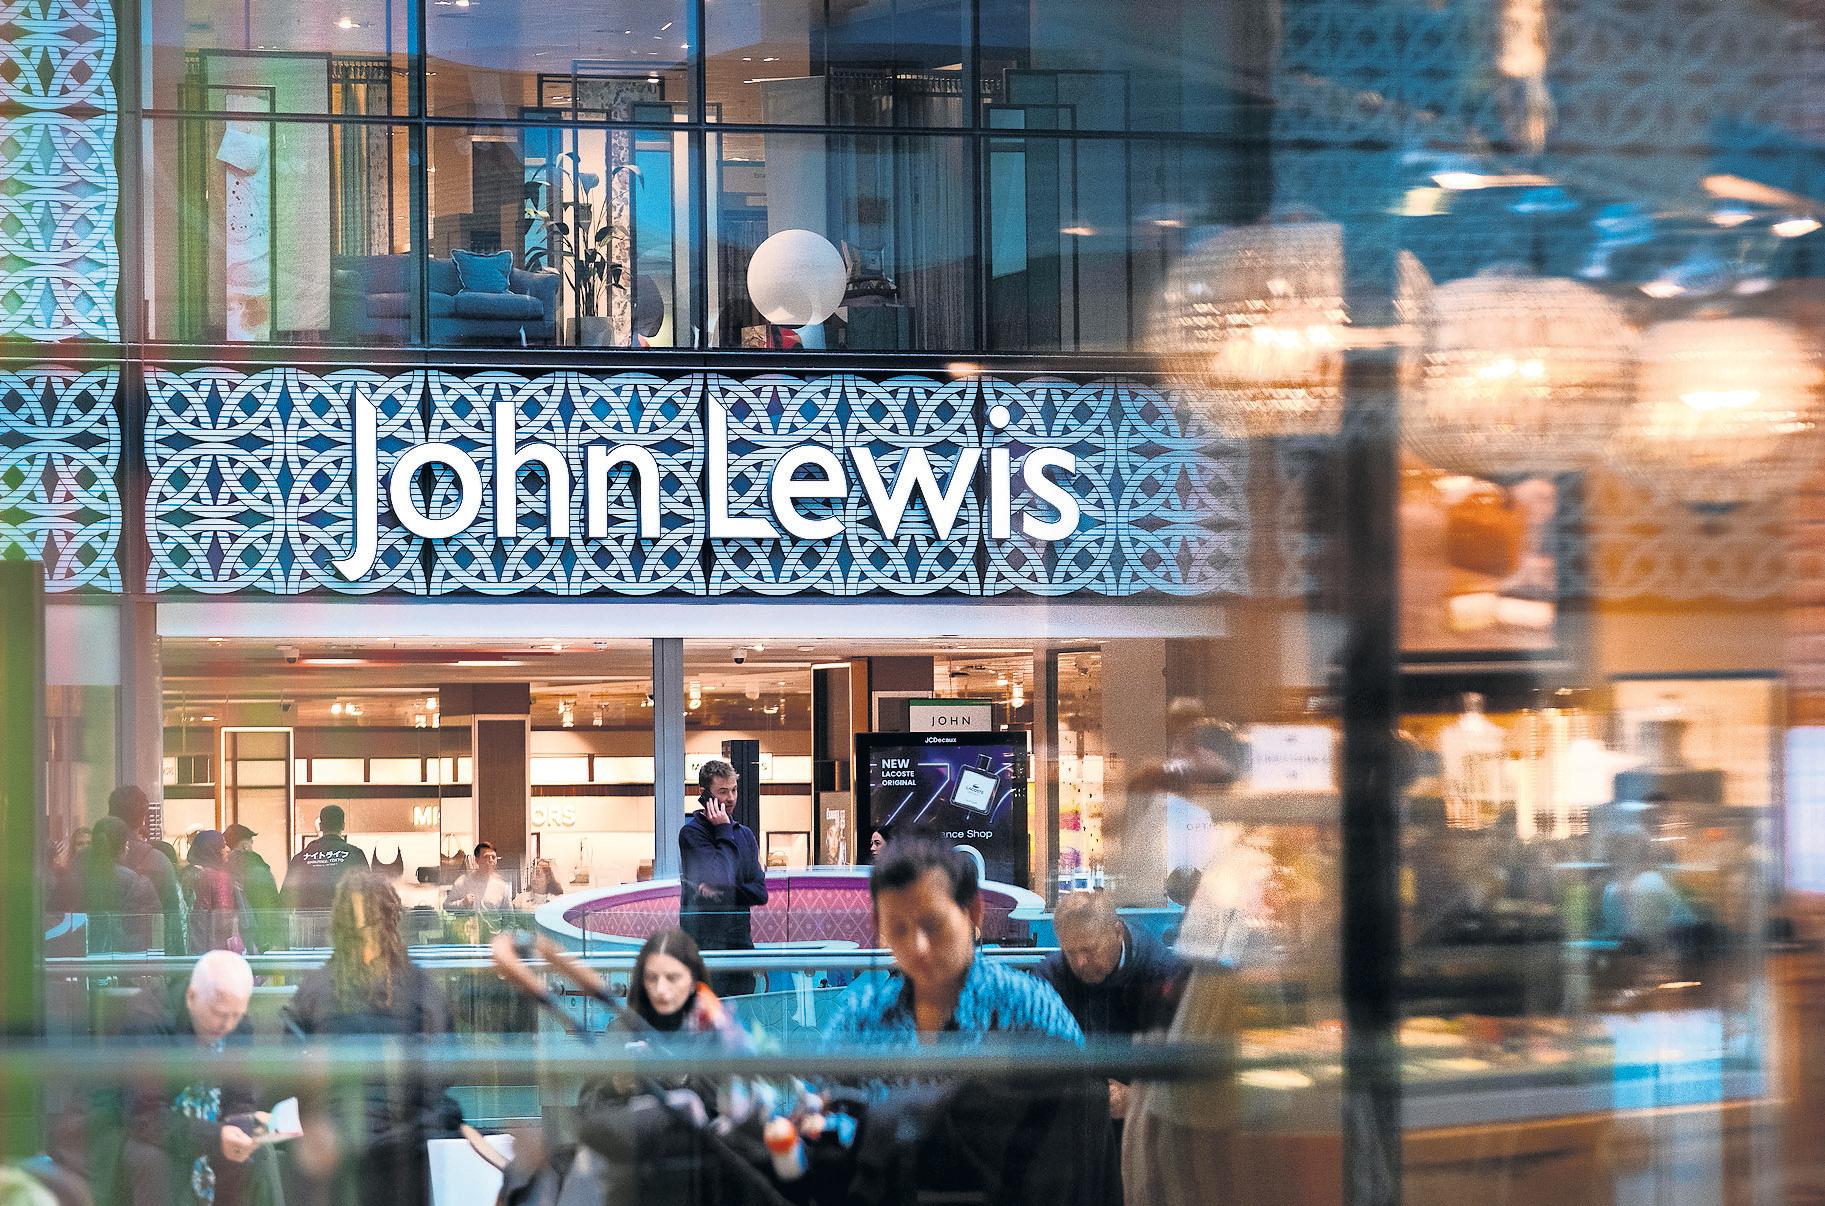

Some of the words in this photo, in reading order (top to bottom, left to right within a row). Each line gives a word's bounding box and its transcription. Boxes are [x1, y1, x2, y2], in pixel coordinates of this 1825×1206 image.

[326, 388, 661, 583] John
[708, 396, 1081, 543] Lewis
[931, 716, 971, 726] JOHN
[881, 758, 910, 768] NEW
[881, 770, 915, 778] LACOSTE
[881, 779, 917, 787] ORIGINAL
[967, 829, 993, 840] Shop
[303, 850, 349, 860] ナイトライフ
